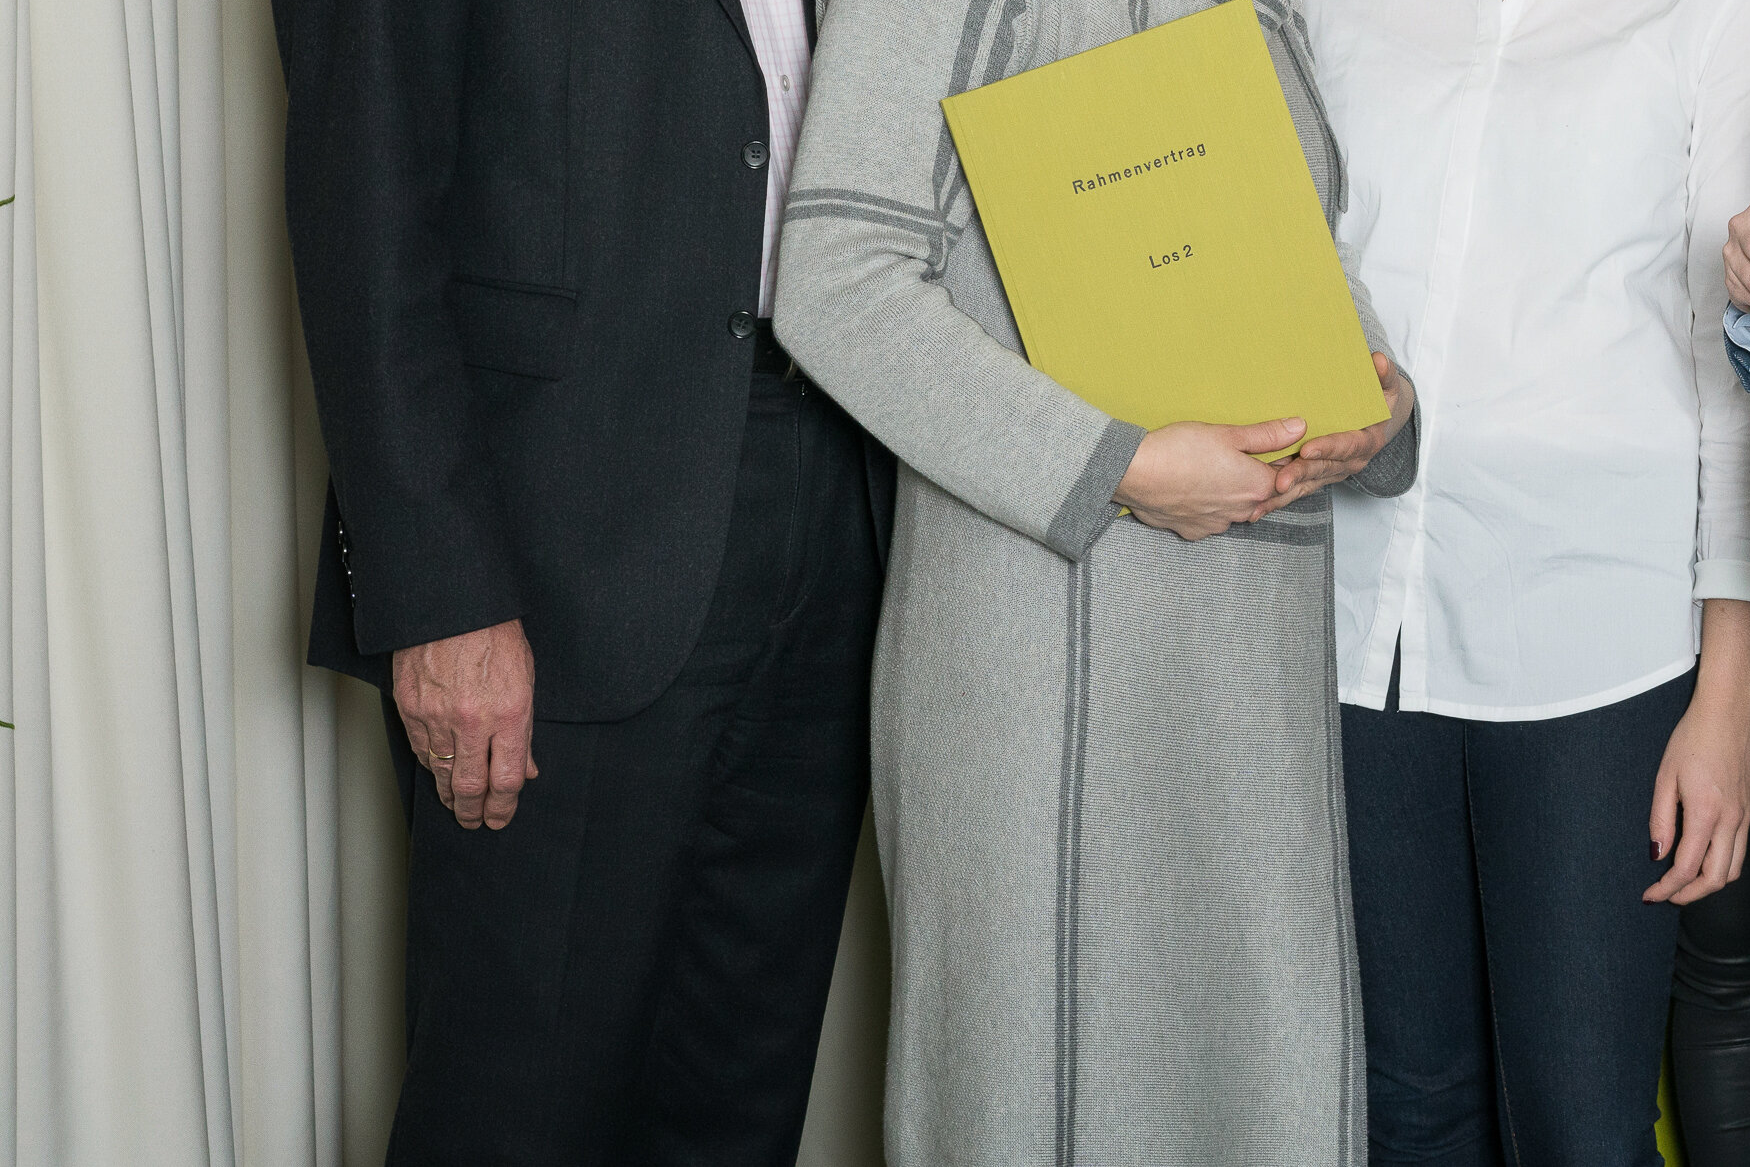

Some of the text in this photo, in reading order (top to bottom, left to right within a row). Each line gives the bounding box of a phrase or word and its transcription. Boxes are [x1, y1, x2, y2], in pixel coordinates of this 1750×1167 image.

[1071, 141, 1207, 195] Rahmenvertrag
[1148, 244, 1194, 270] Los 2
